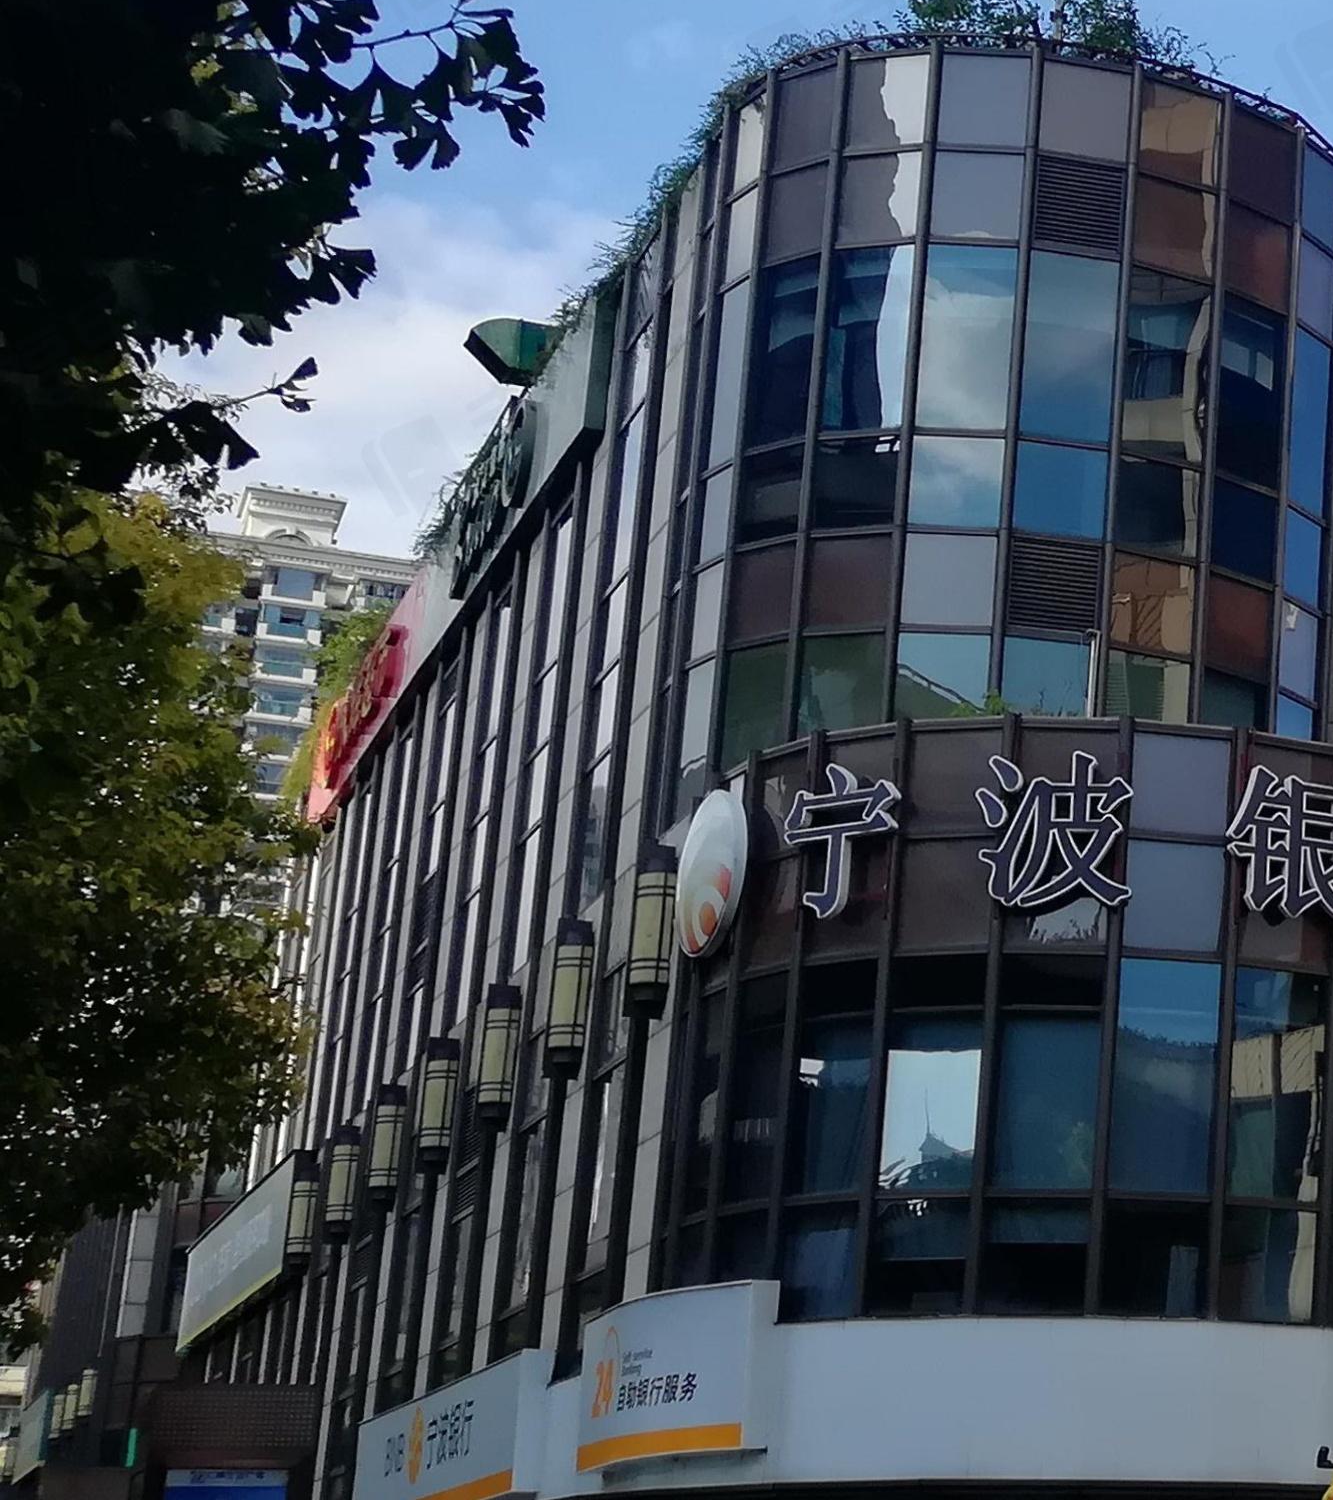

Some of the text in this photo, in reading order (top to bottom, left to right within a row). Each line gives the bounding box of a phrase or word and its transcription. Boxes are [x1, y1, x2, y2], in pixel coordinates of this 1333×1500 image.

[616, 1372, 698, 1412] 自助银行服务
[426, 1399, 475, 1470] 宁波银行
